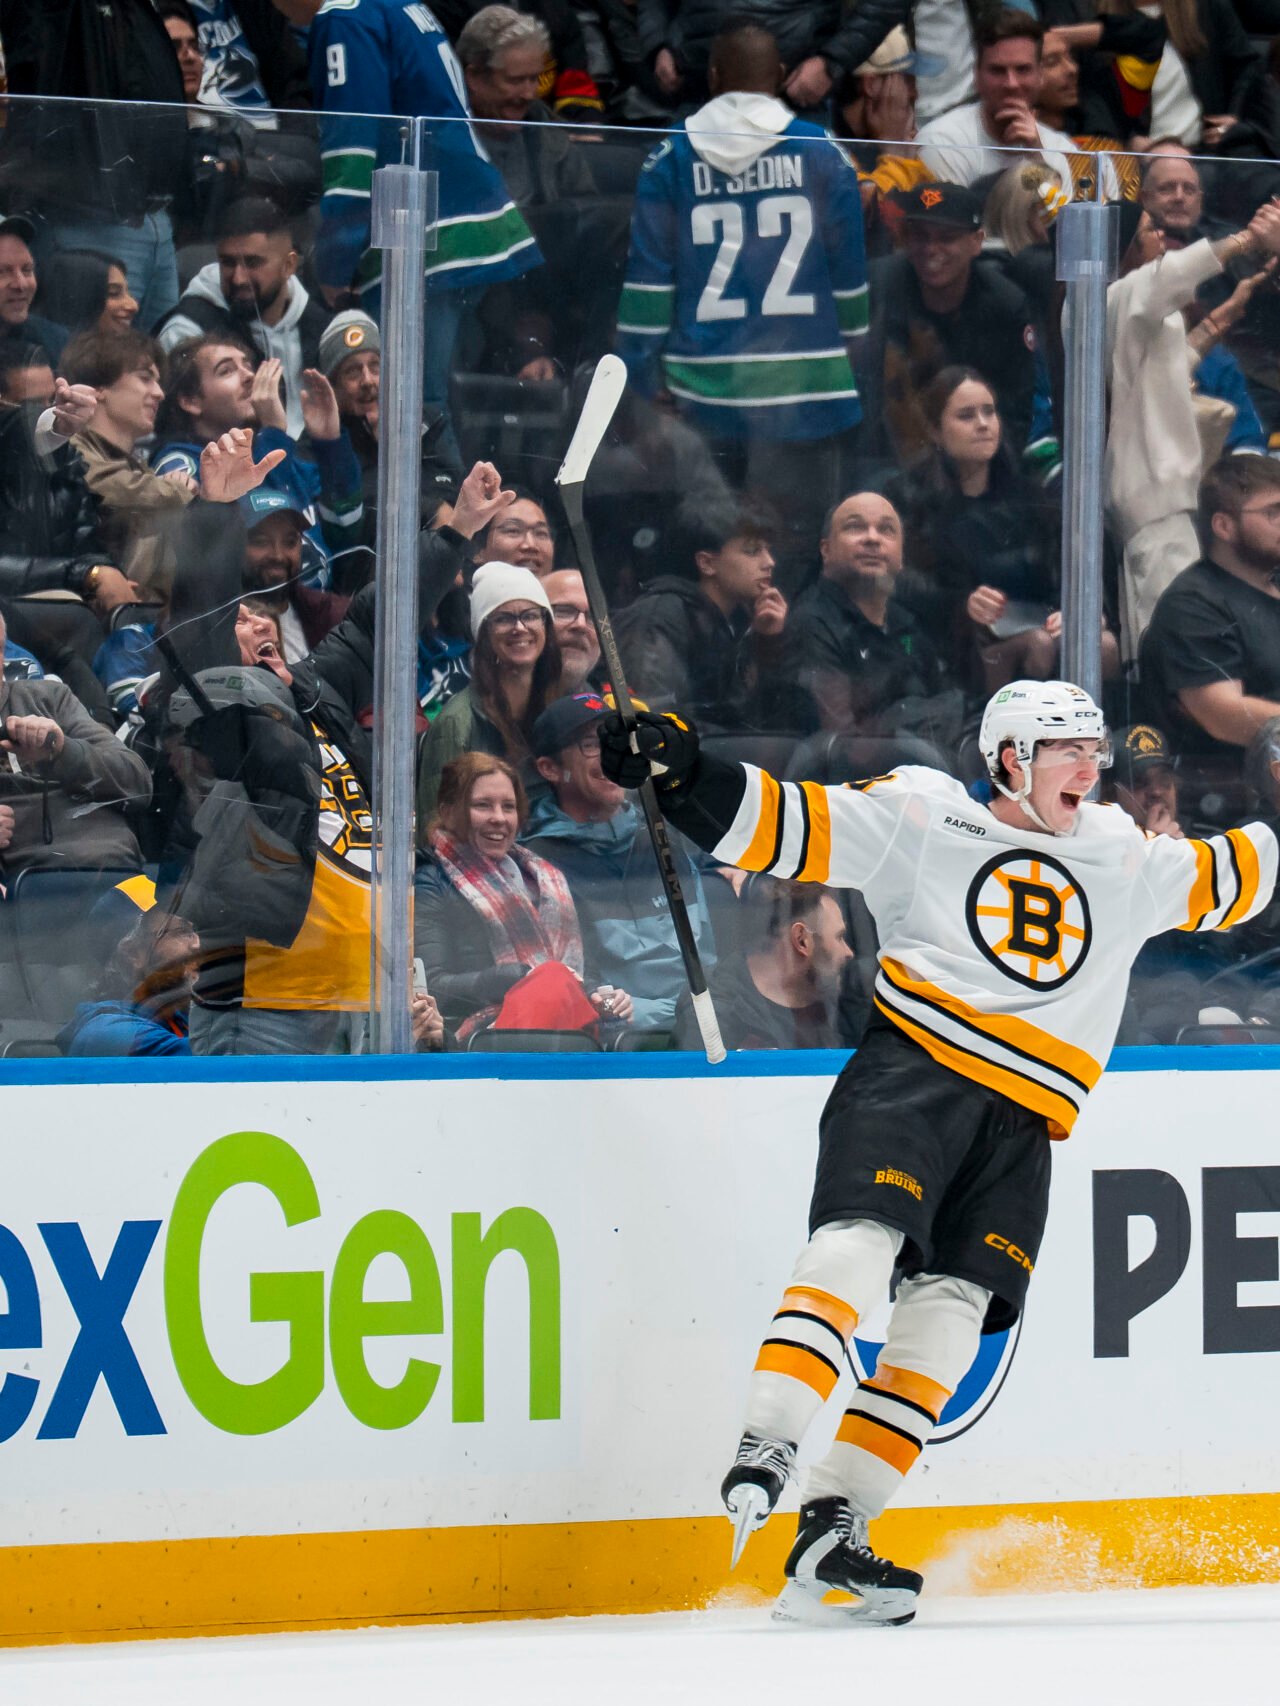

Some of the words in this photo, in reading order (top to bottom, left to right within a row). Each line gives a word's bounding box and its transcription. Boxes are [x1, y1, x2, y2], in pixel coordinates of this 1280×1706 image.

[327, 43, 347, 87] 9
[691, 195, 815, 322] 22
[874, 1169, 923, 1201] BRUINS
